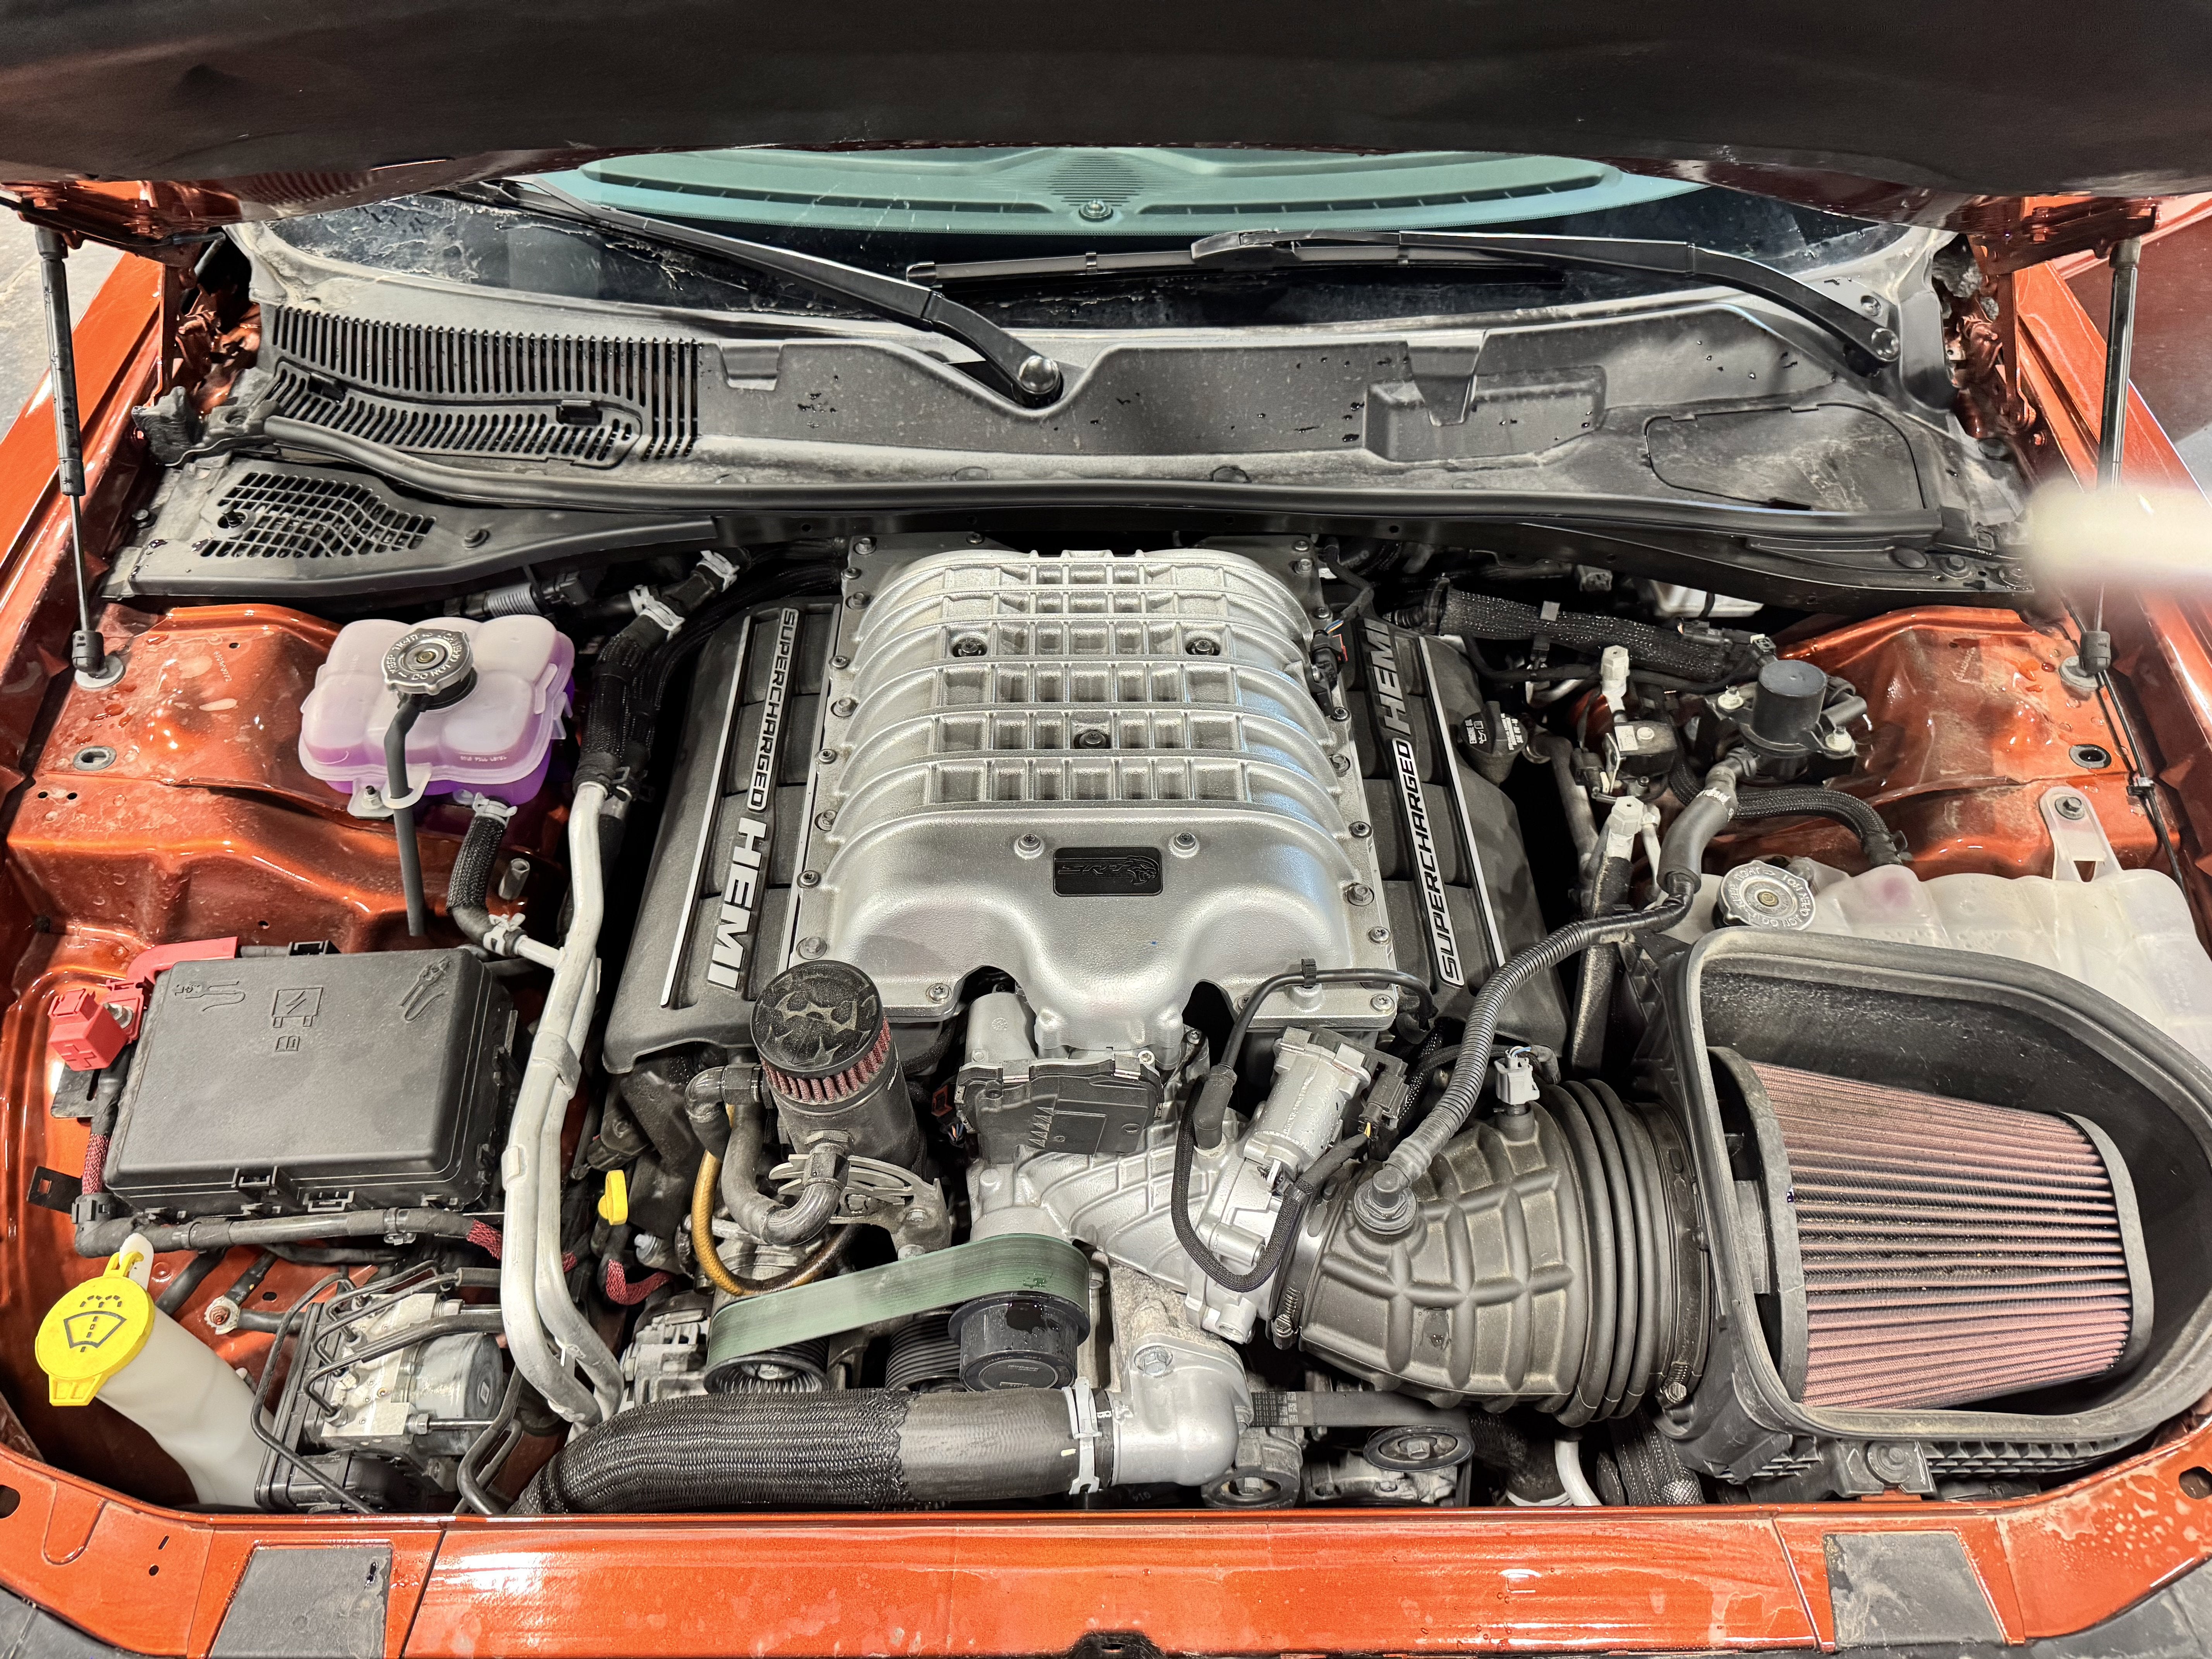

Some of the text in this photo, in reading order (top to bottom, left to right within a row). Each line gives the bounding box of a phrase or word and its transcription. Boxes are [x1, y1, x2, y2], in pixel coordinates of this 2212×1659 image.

[430, 663, 451, 677] NOT
[749, 609, 798, 808] SUPERCHARGED
[1364, 618, 1412, 737] HEMI
[1467, 726, 1477, 744] ENGINE
[707, 817, 767, 990] HEMI
[1058, 864, 1131, 876] SRT
[1396, 741, 1462, 982] SUPERCHARGED
